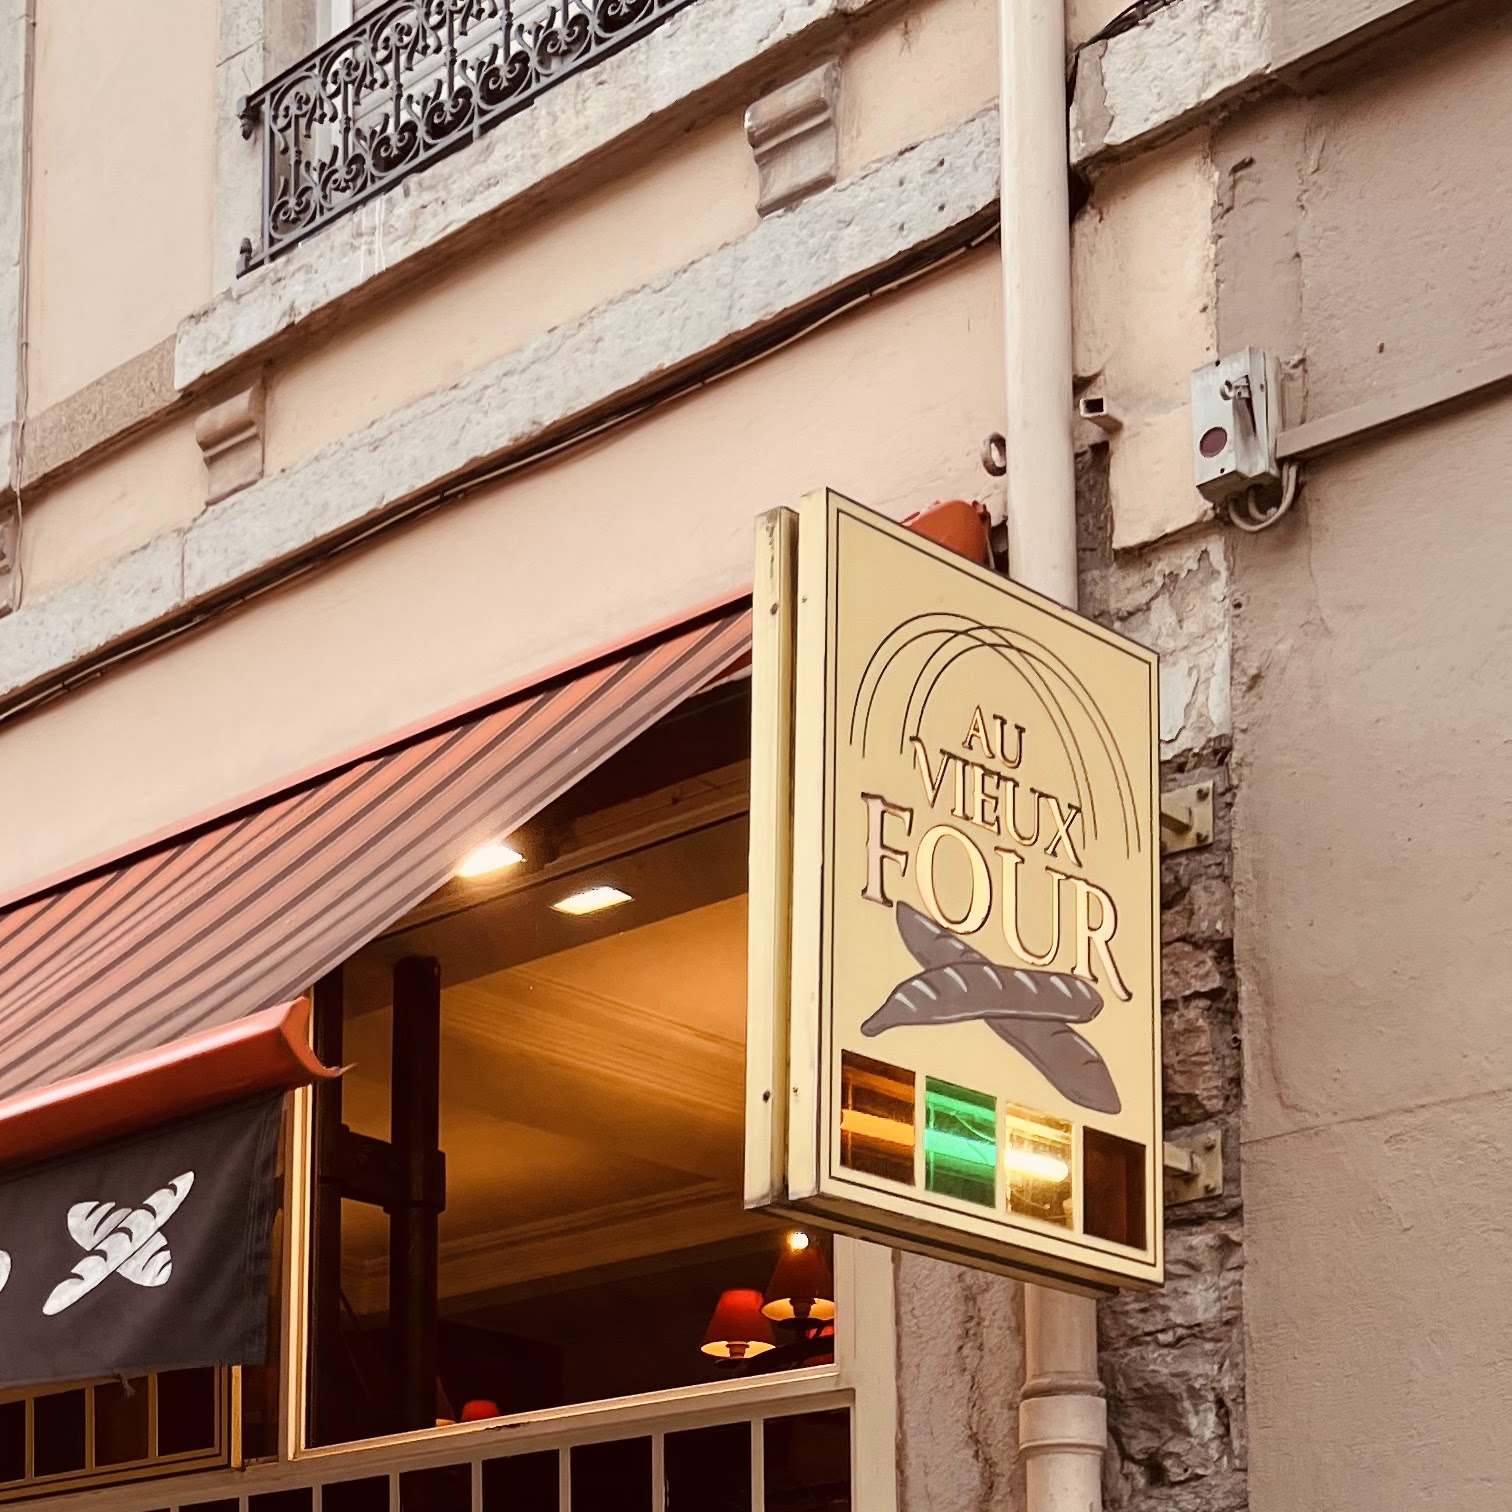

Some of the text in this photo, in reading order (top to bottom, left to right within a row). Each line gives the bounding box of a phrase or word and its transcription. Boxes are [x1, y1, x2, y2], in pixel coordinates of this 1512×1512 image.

[909, 735, 1082, 868] VIEUX
[961, 704, 1026, 769] AU
[860, 791, 1133, 1002] FOUR
